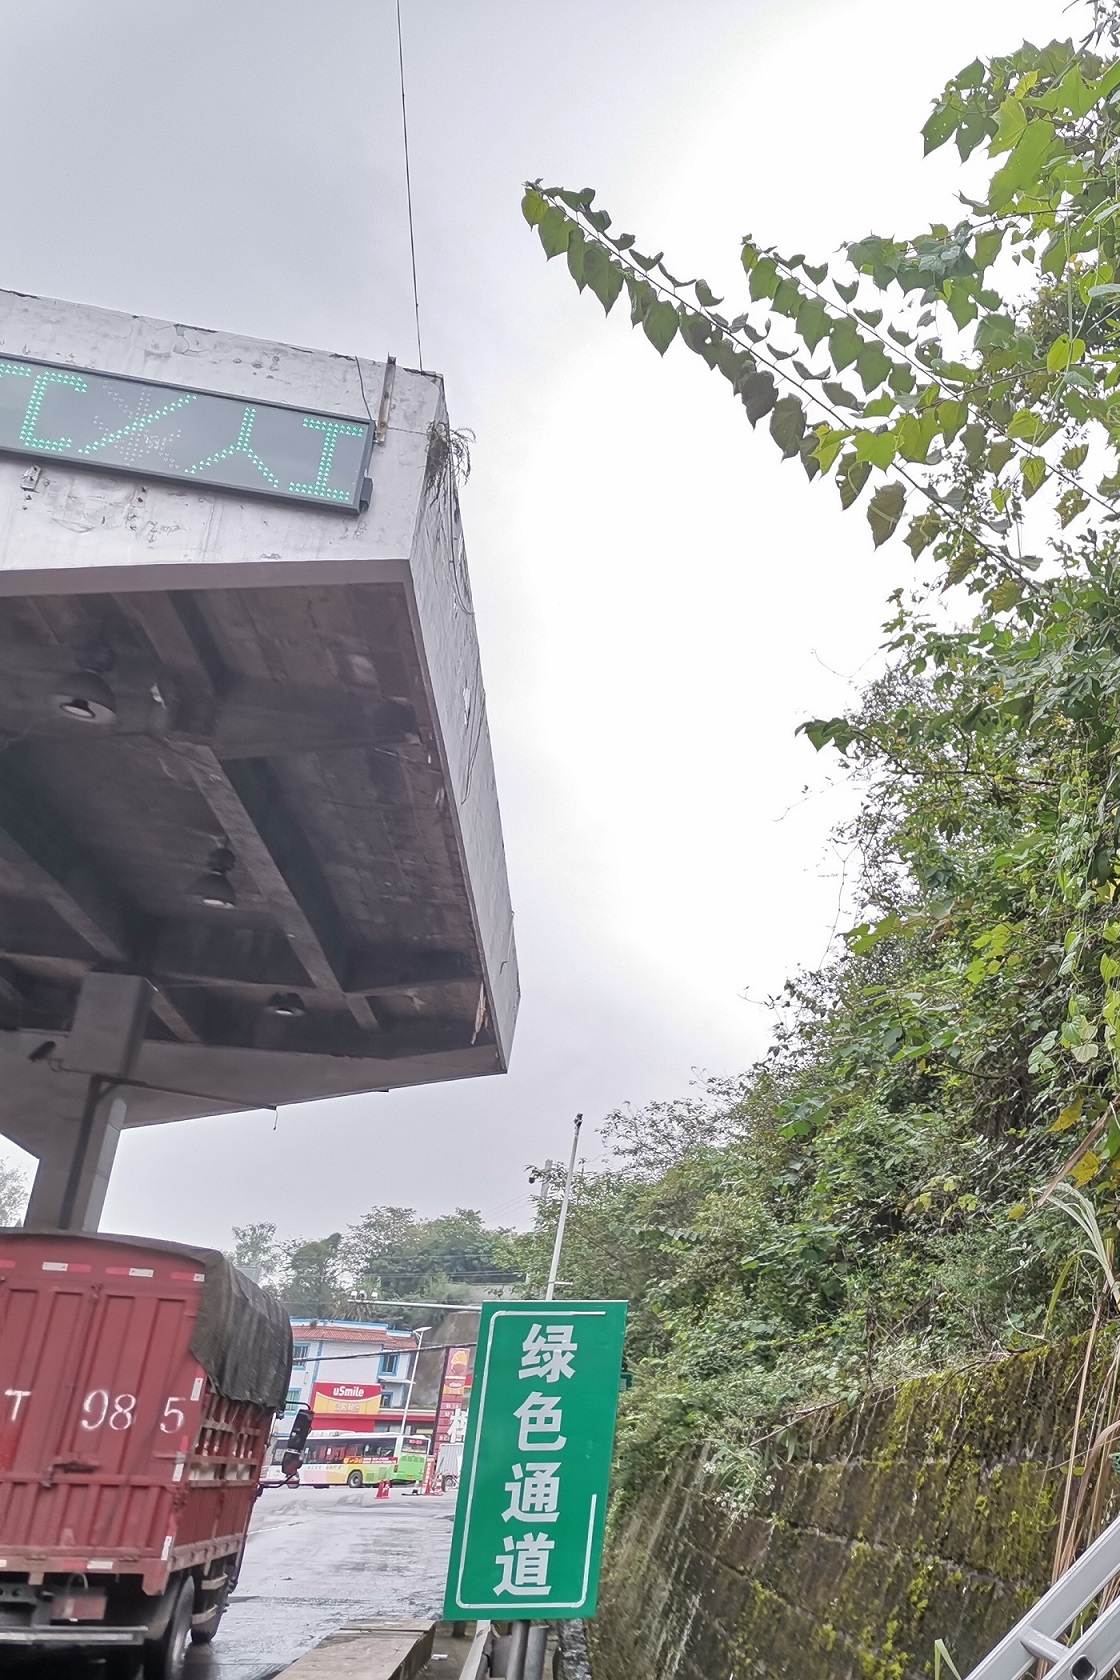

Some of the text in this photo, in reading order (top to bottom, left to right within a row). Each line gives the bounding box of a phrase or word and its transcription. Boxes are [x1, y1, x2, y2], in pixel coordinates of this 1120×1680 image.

[333, 1385, 364, 1397] uSmile
[492, 1323, 578, 1597] 绿色通道
